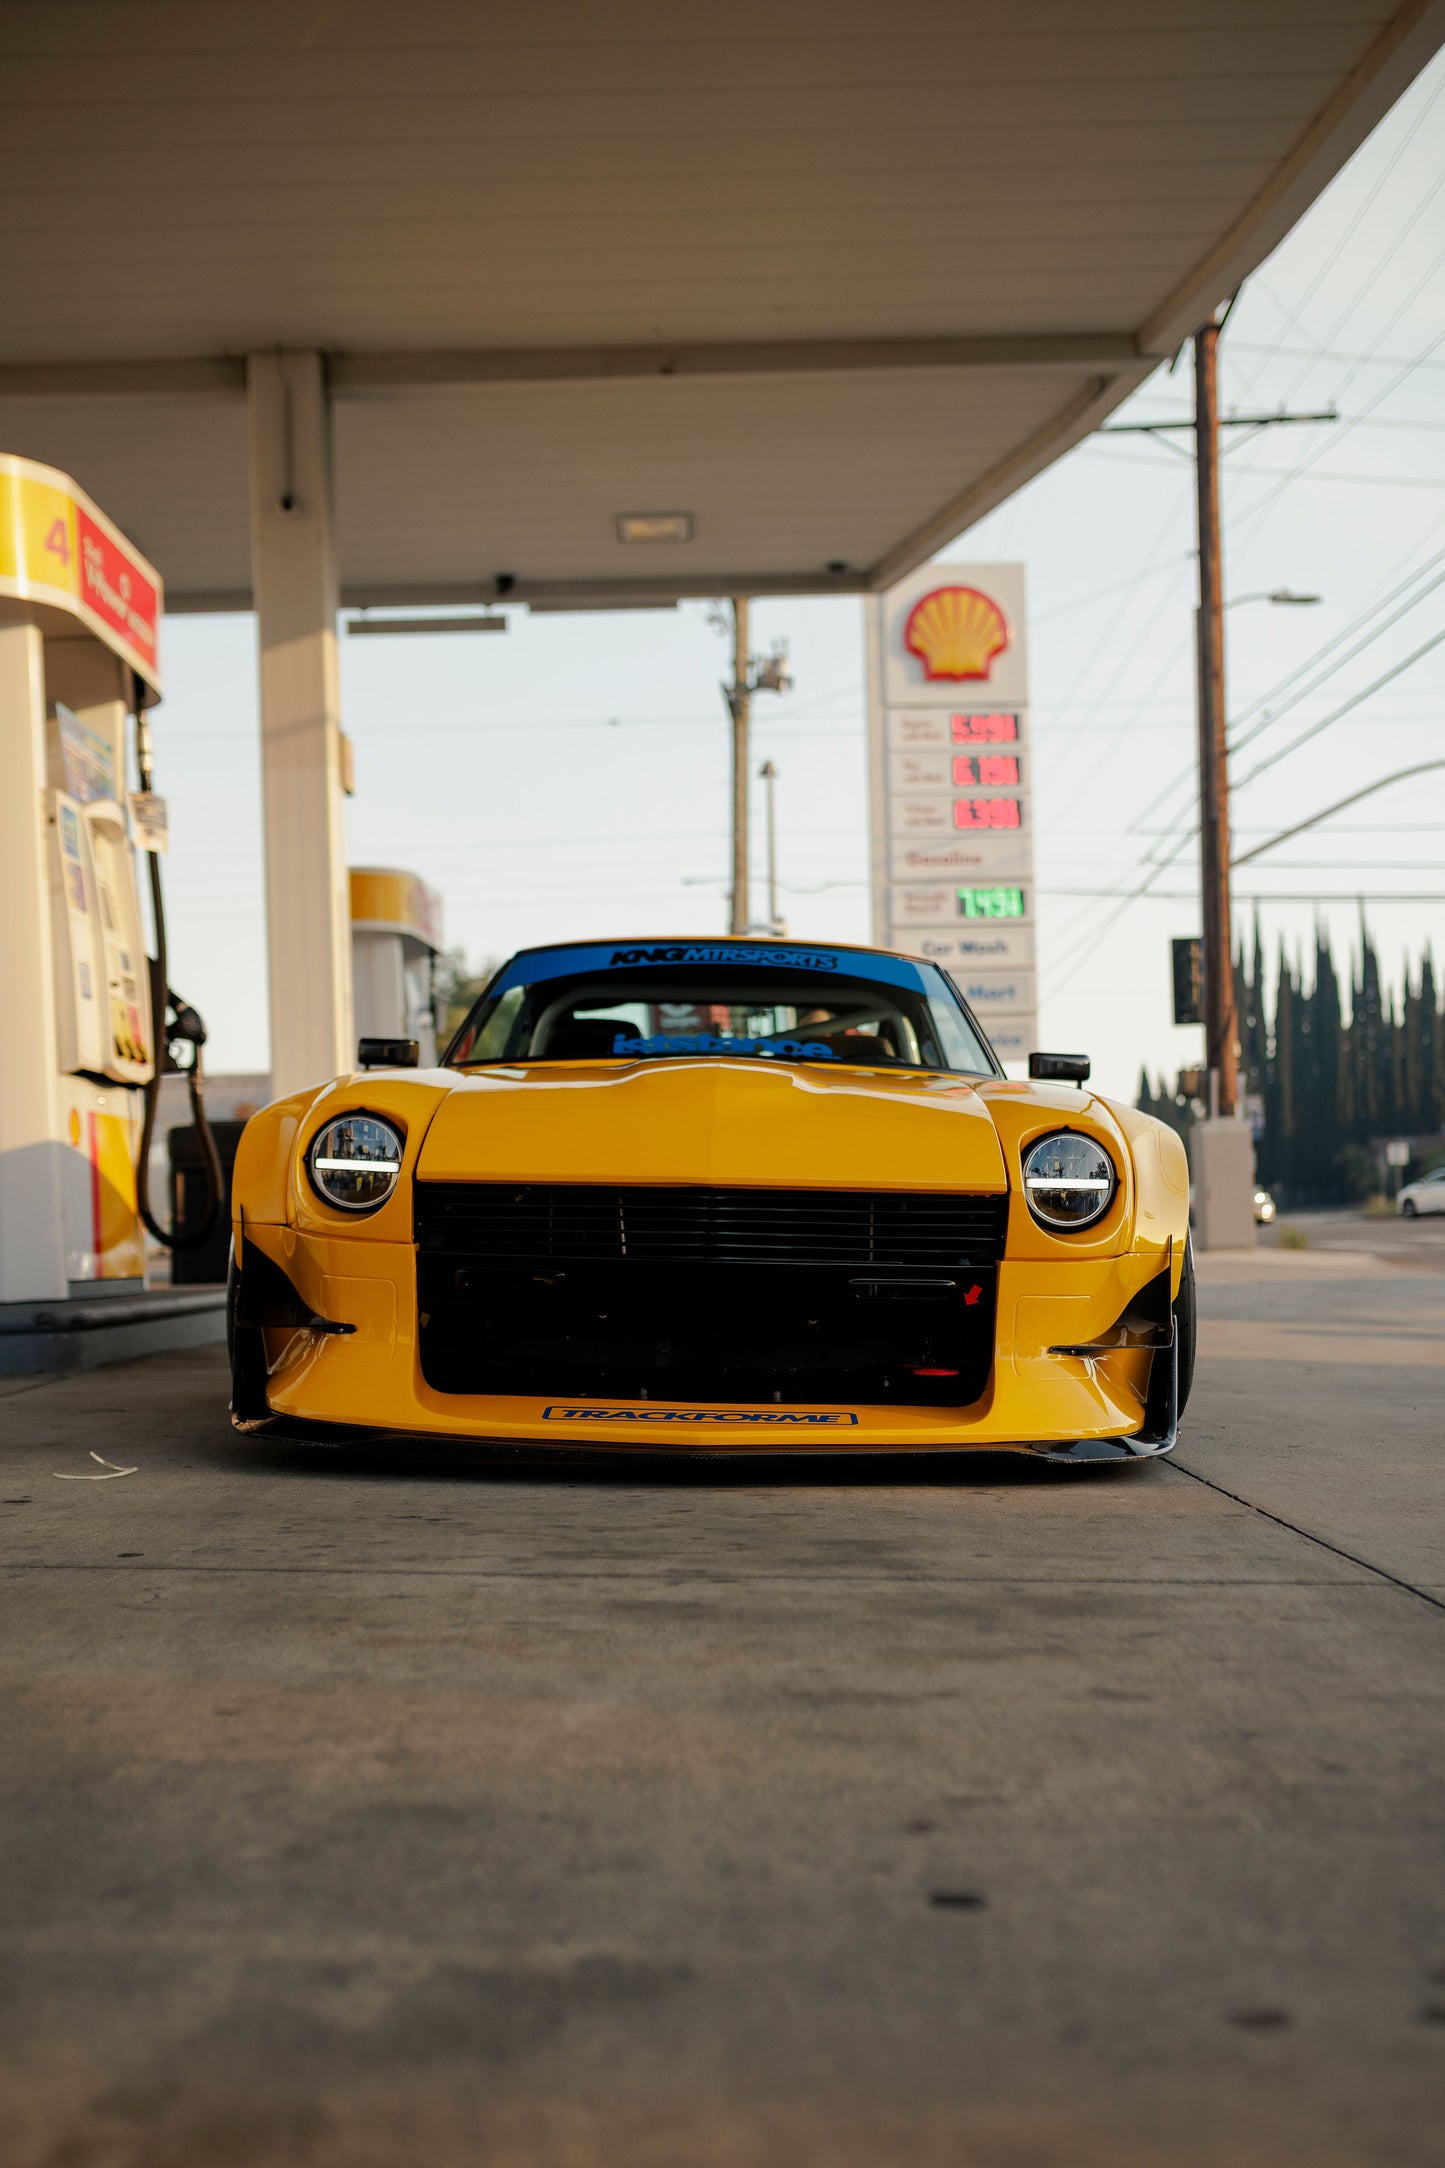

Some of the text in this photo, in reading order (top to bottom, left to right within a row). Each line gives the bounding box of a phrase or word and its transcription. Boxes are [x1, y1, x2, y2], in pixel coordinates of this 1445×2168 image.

[44, 516, 71, 567] 4
[905, 851, 983, 866] Gasoline
[922, 940, 1008, 955] Car Wash
[968, 985, 1016, 1000] Mart
[561, 1409, 841, 1423] TRACKFORME
